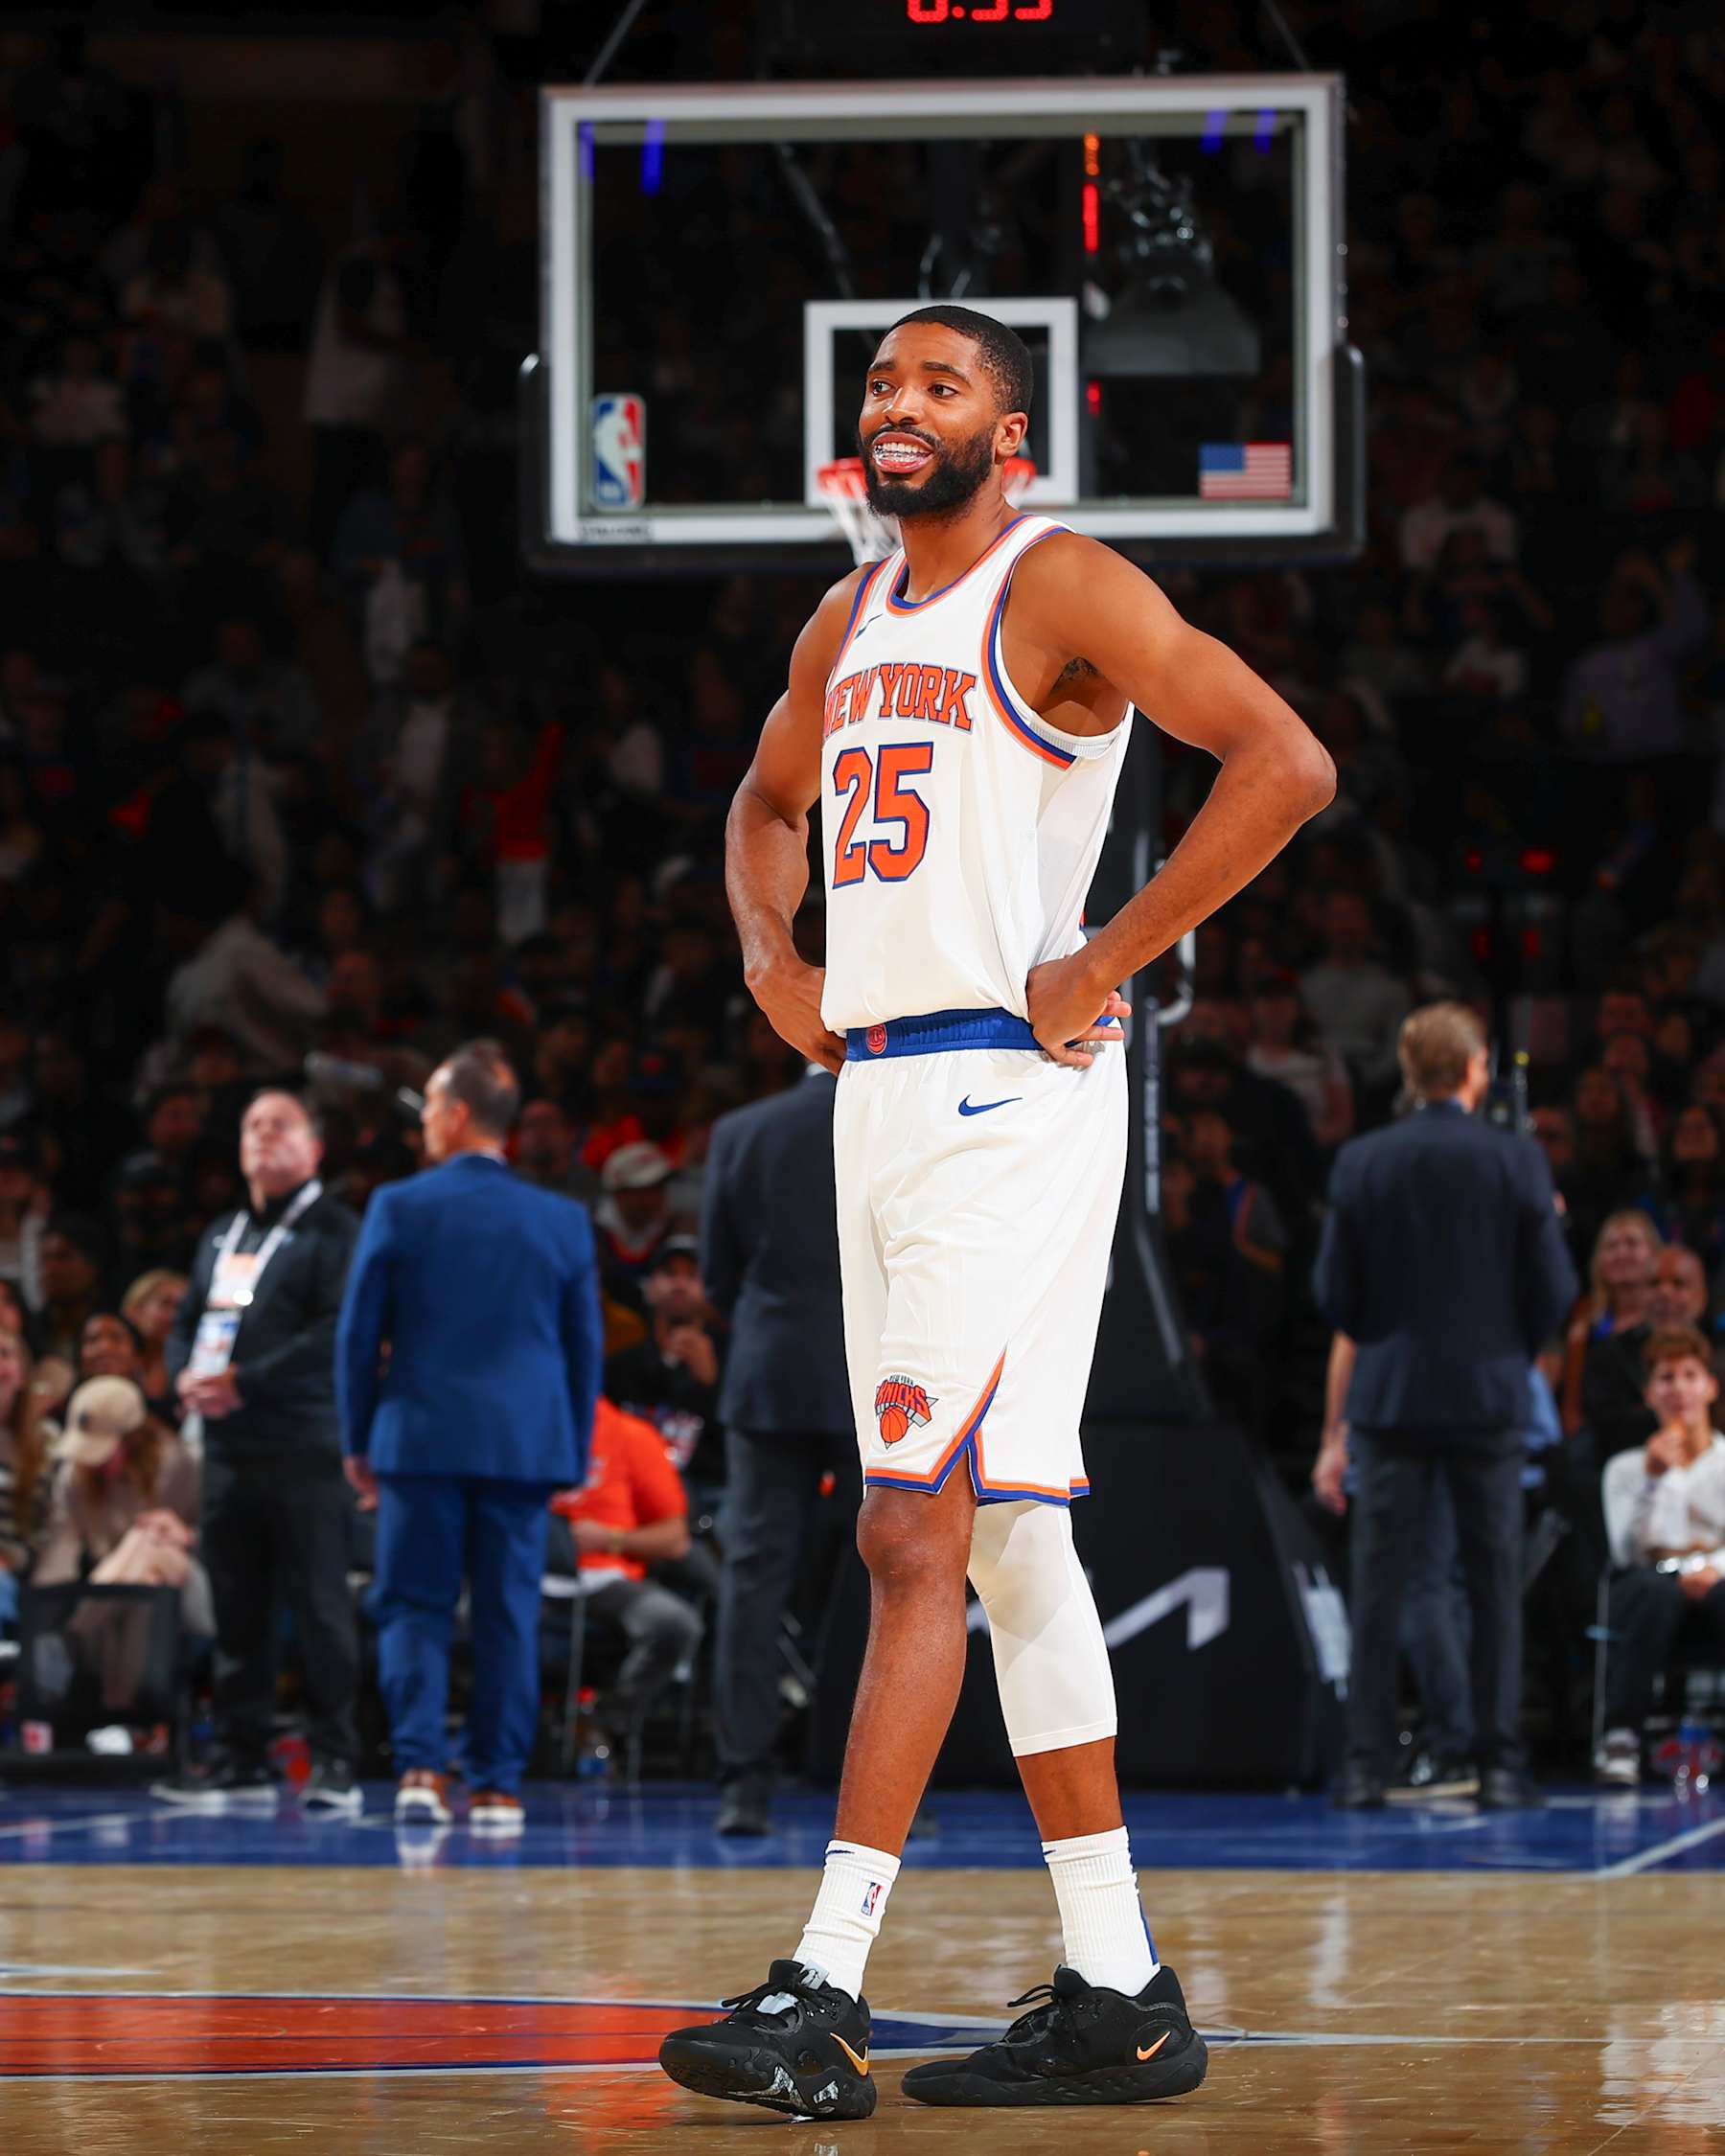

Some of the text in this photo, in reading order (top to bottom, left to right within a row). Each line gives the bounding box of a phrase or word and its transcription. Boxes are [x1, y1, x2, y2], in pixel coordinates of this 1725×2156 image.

[877, 662, 978, 734] YORK
[833, 741, 933, 890] 25
[875, 1379, 932, 1421] KNICKS
